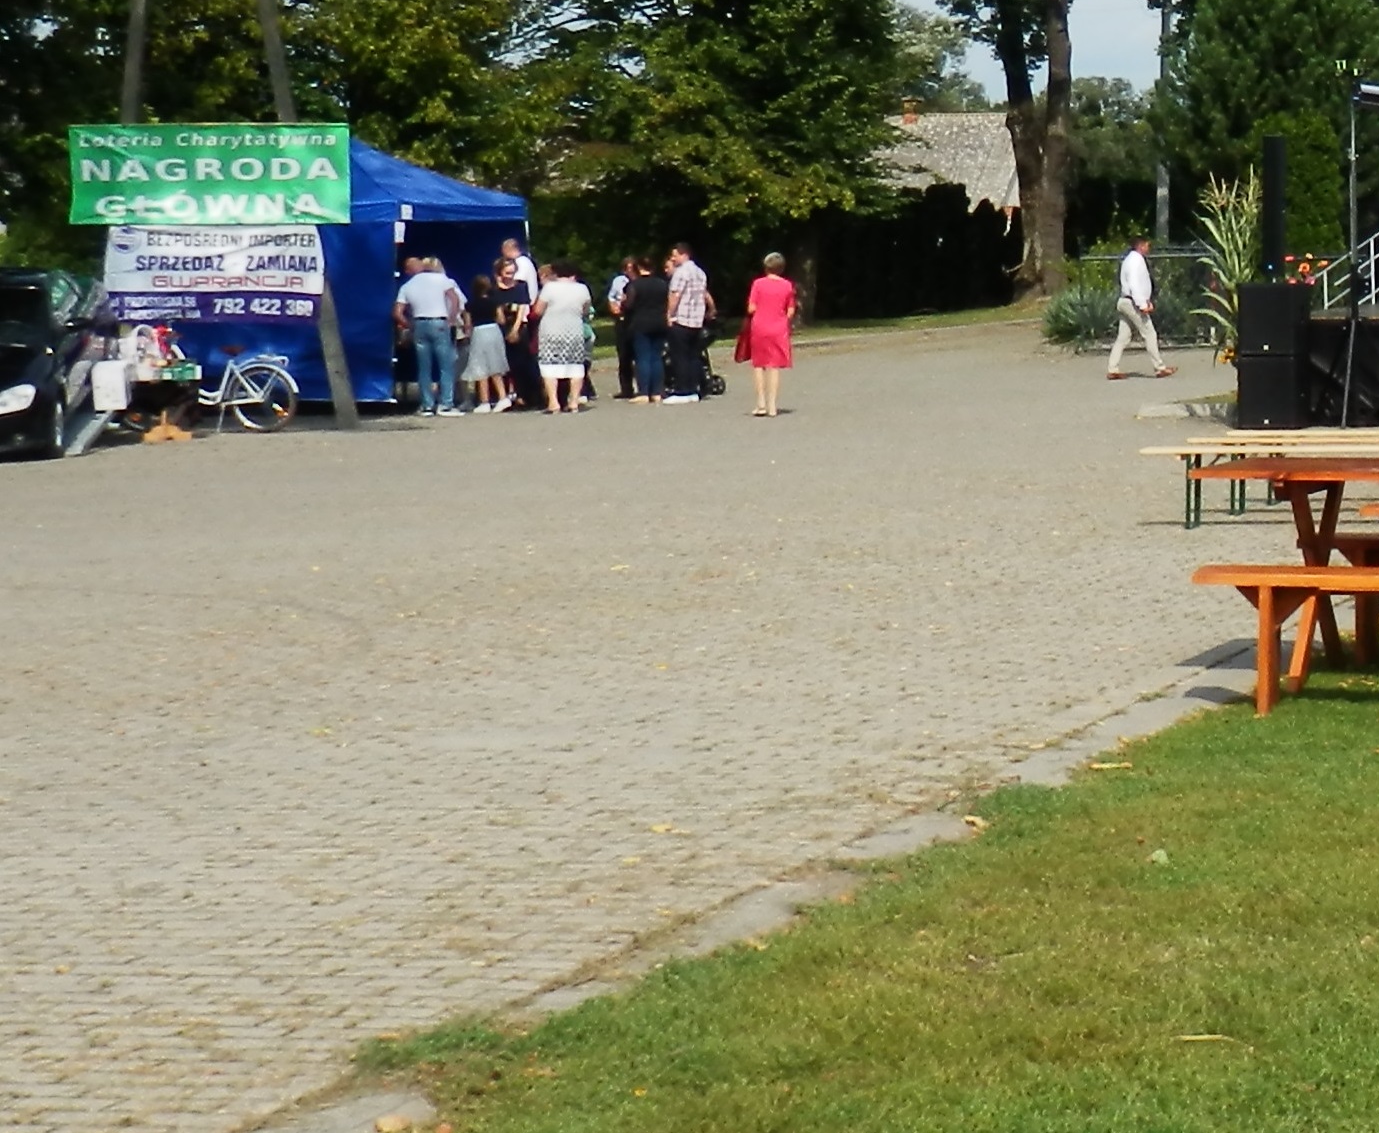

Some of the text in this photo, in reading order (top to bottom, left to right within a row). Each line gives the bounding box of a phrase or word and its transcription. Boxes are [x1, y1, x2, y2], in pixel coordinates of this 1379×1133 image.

[79, 132, 337, 149] Loteria Charytatywna
[79, 157, 339, 182] NAGRODA
[94, 188, 326, 219] GŁÓWNA
[246, 254, 318, 272] ZAMIANA
[152, 275, 304, 289] GWARANCJA
[213, 297, 246, 315] 792
[249, 297, 282, 316] 422
